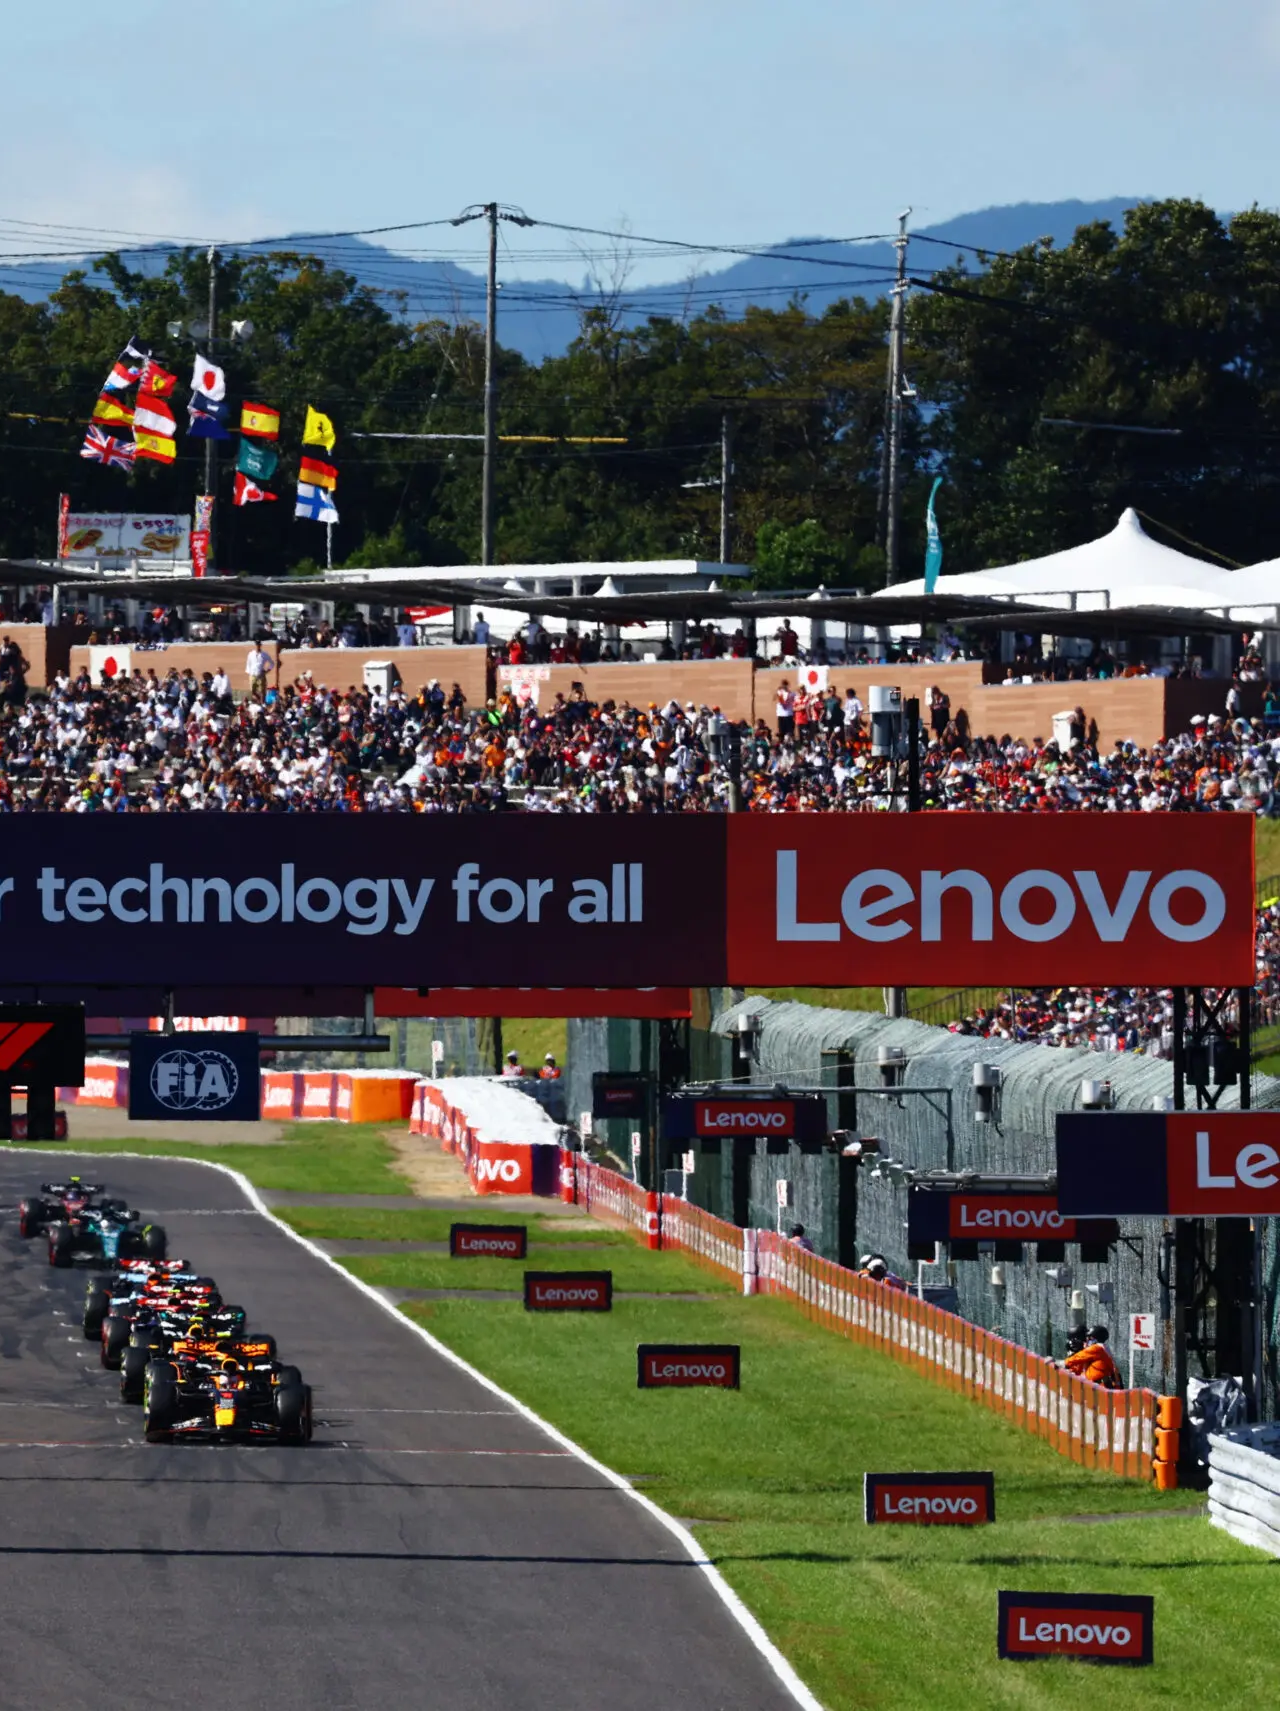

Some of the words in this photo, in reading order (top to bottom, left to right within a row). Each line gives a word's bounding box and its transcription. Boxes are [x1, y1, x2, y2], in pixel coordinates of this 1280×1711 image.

[36, 863, 435, 935] technology
[452, 863, 543, 922] for
[568, 863, 642, 922] all
[777, 850, 1226, 942] Lenovo
[704, 1109, 786, 1127] Lenovo
[960, 1204, 1064, 1228] Lenovo
[461, 1237, 516, 1251] Lenovo
[536, 1286, 599, 1301] Lenovo
[651, 1361, 726, 1379] Lenovo
[884, 1493, 978, 1515] Lenovo
[1019, 1617, 1131, 1646] Lenovo
